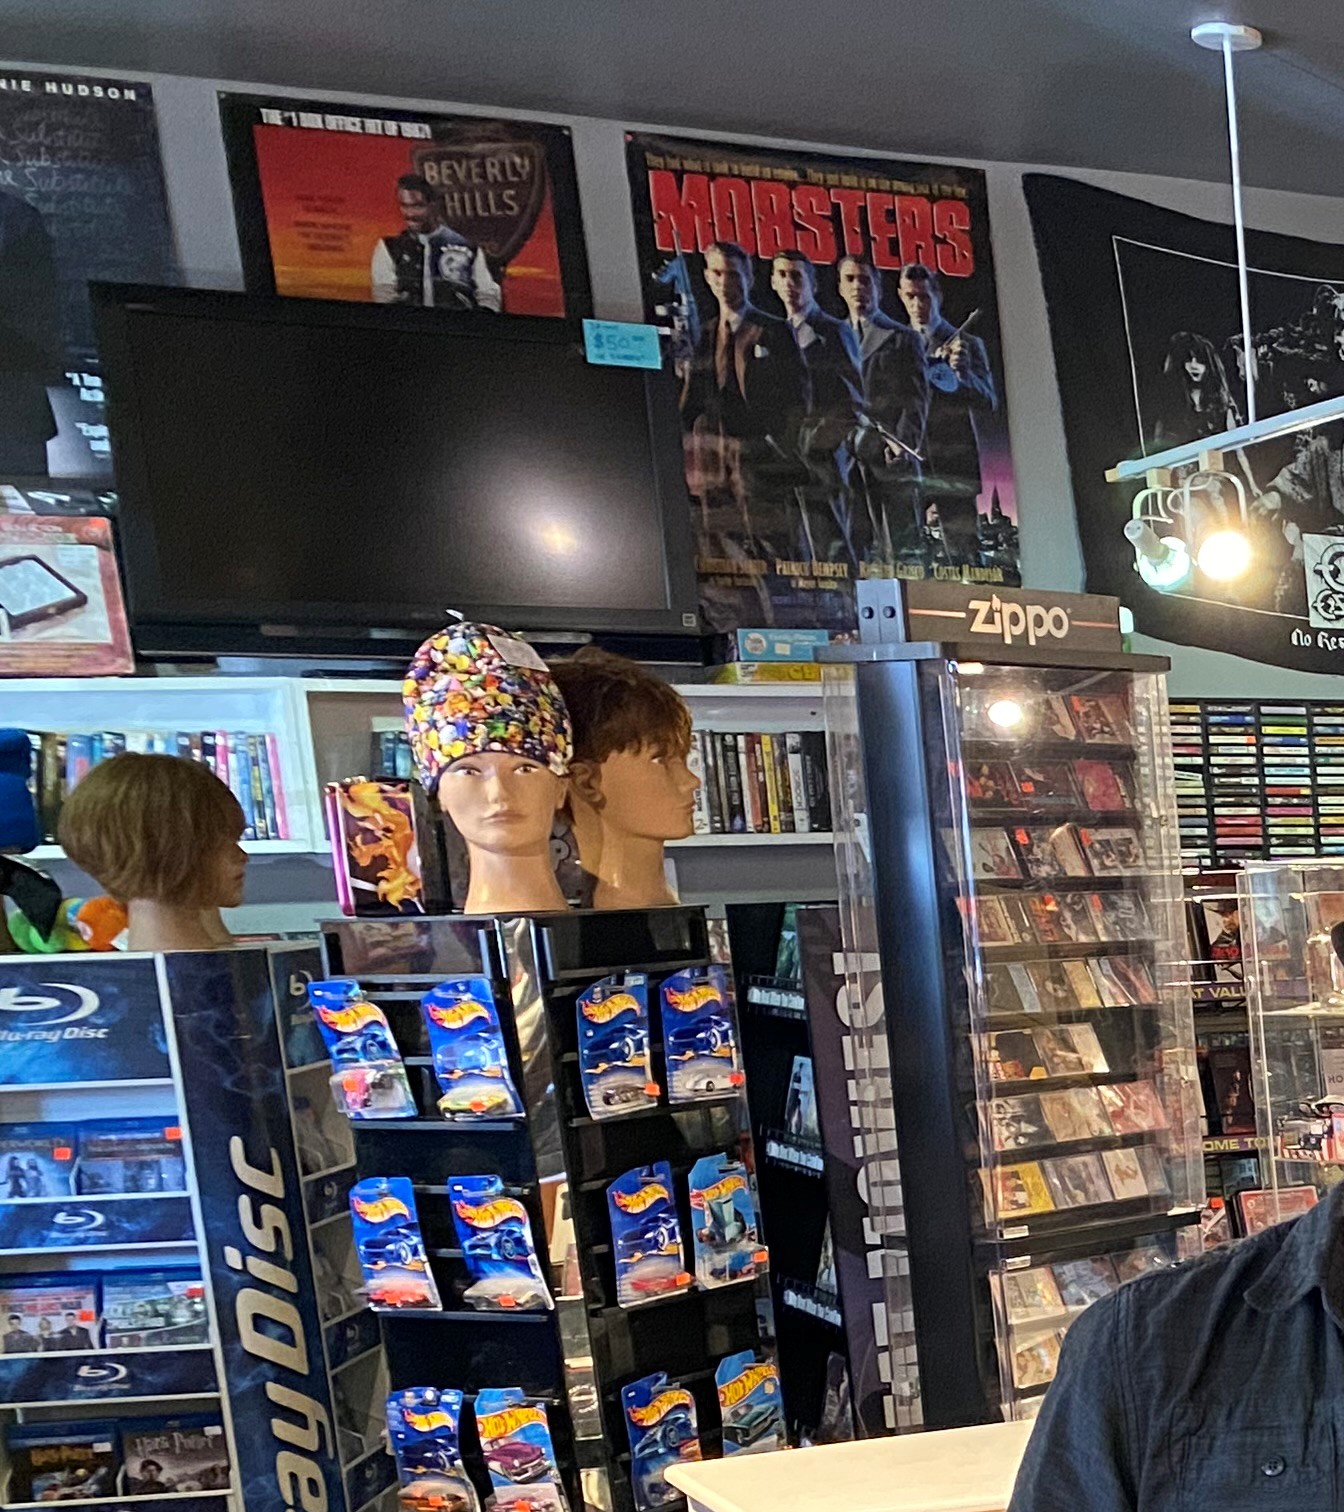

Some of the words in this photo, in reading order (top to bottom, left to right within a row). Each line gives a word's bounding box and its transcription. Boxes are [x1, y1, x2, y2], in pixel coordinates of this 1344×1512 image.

[45, 81, 136, 101] HUDSON
[424, 154, 531, 185] BEVERLY
[444, 190, 520, 217] HILLS
[648, 169, 975, 278] MOBSTERS
[1291, 628, 1312, 649] No
[62, 1026, 109, 1040] Disc
[1202, 1137, 1240, 1152] OME
[227, 1134, 310, 1373] Disc
